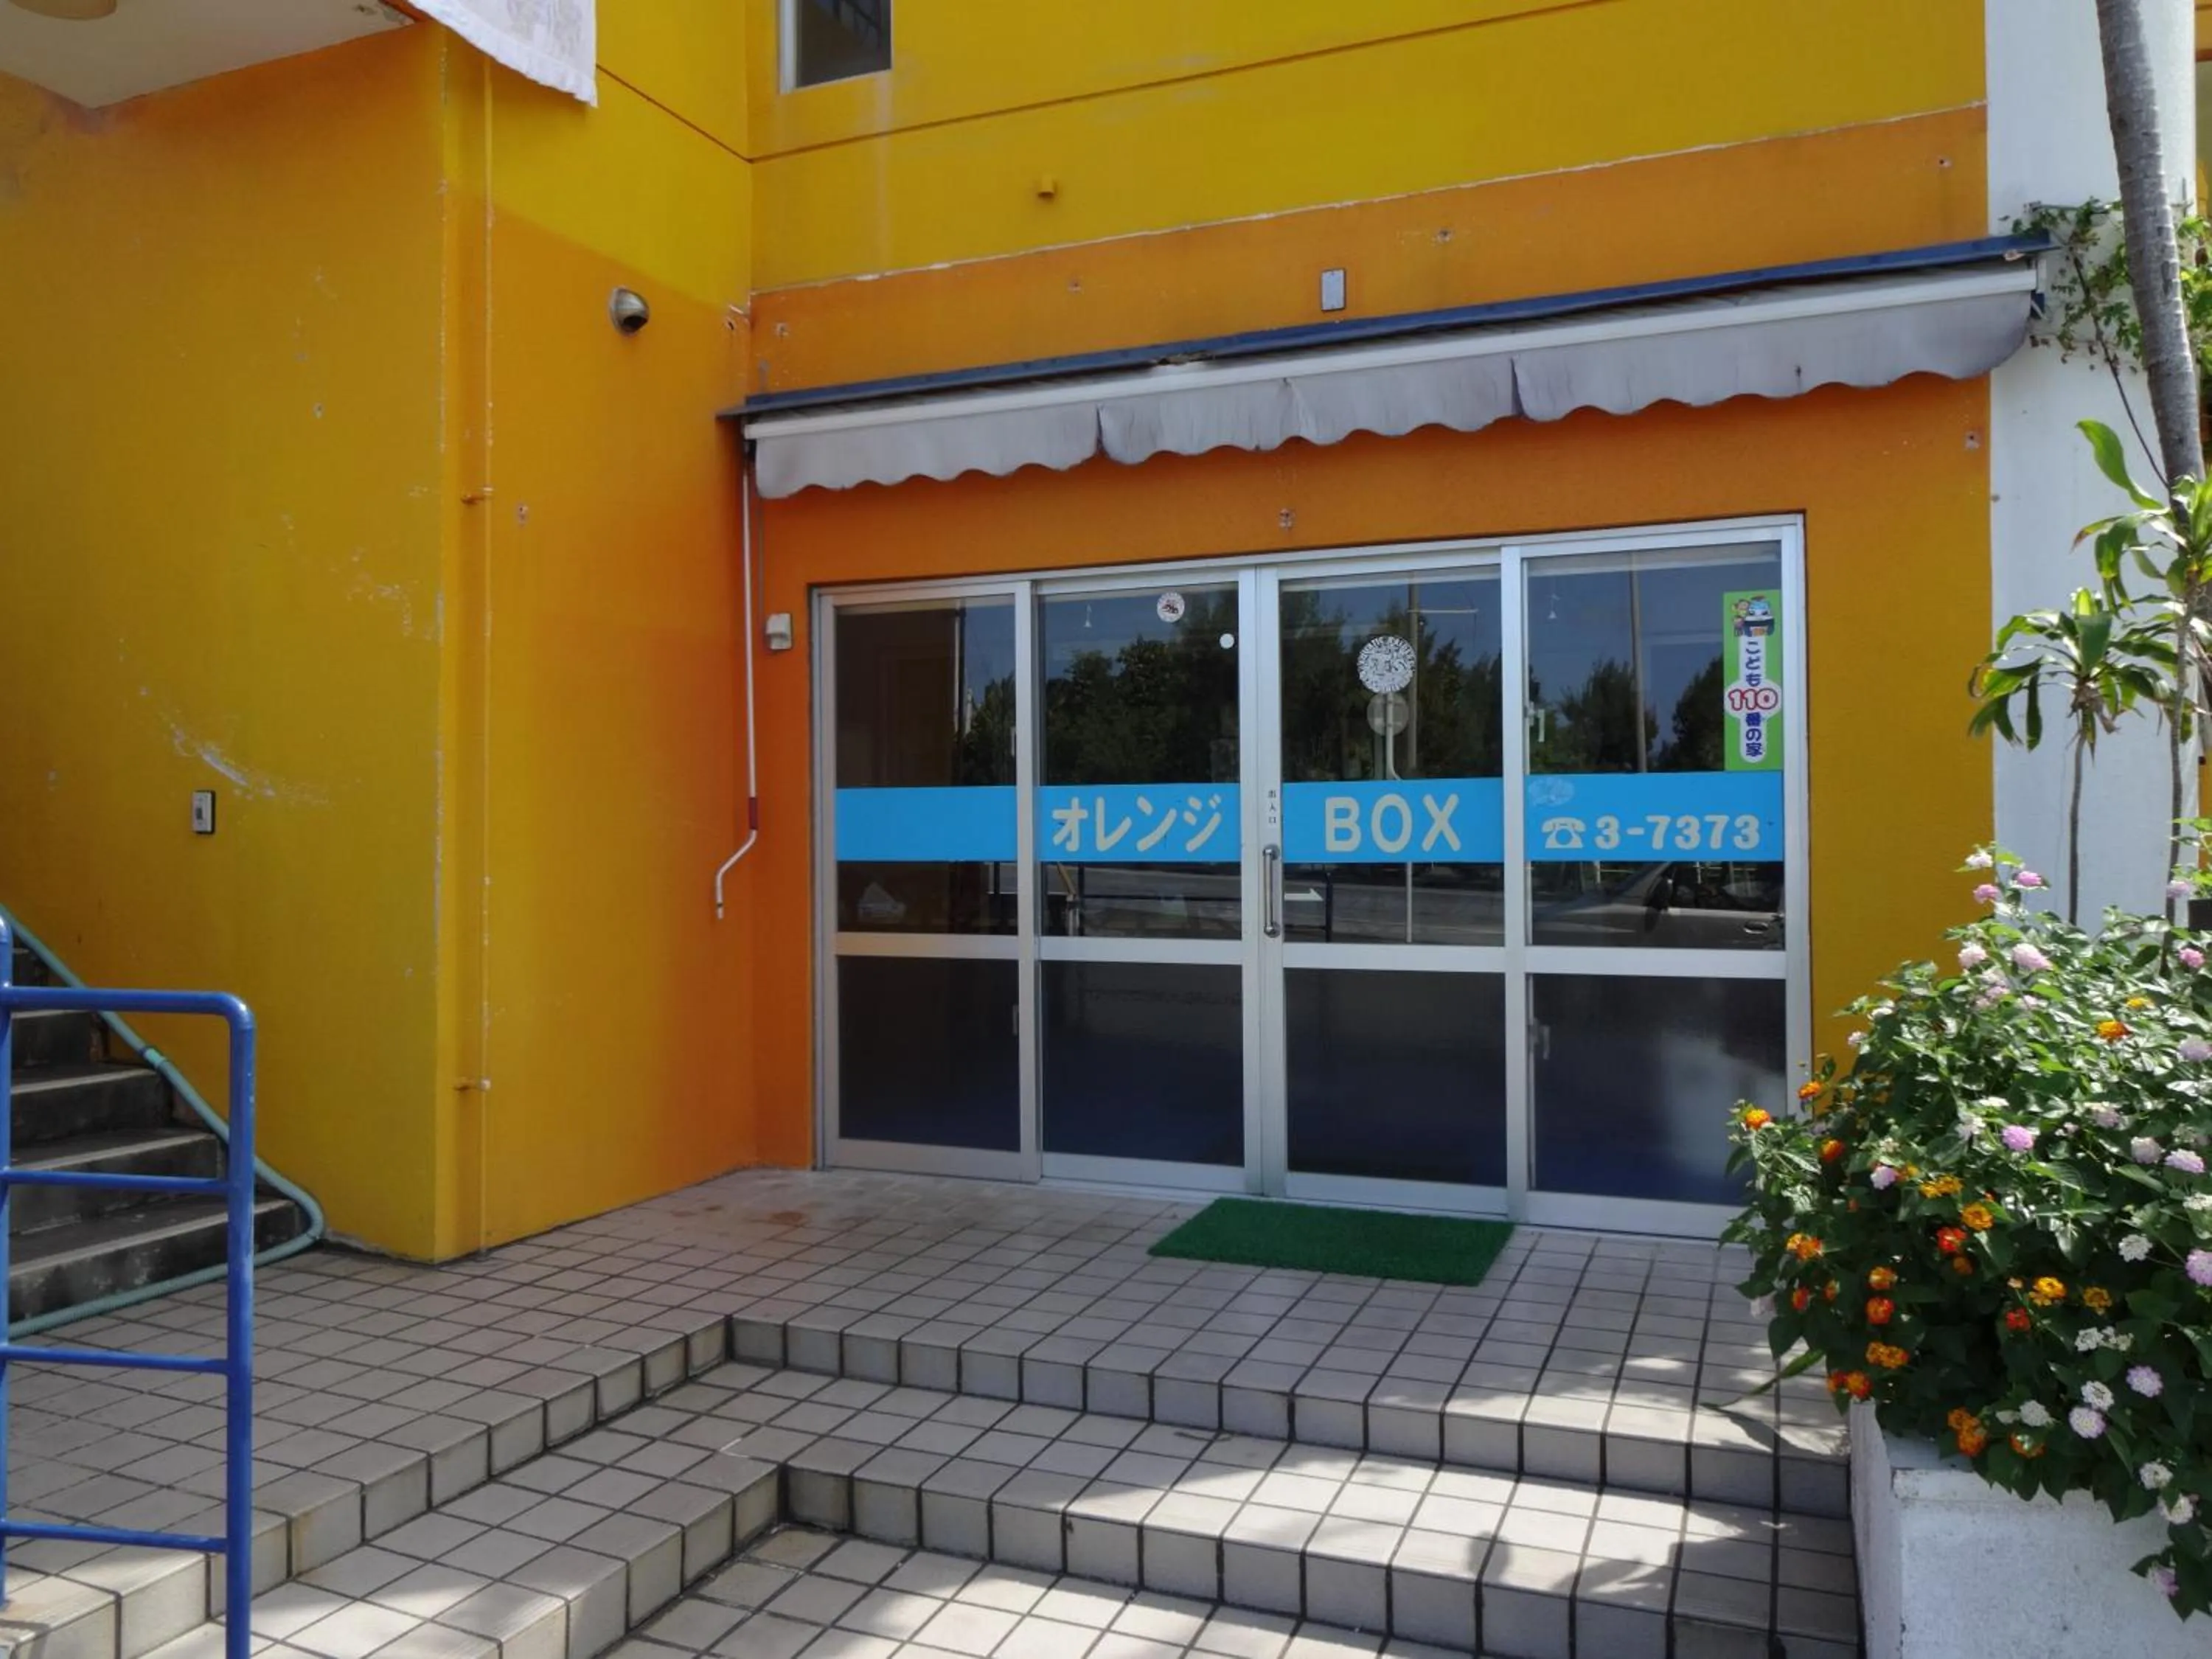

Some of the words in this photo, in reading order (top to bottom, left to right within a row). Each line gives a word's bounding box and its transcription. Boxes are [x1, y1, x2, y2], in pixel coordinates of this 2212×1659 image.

[1052, 793, 1222, 852] オレンジ
[1325, 793, 1461, 853] BOX
[1594, 814, 1760, 850] 3-7373
